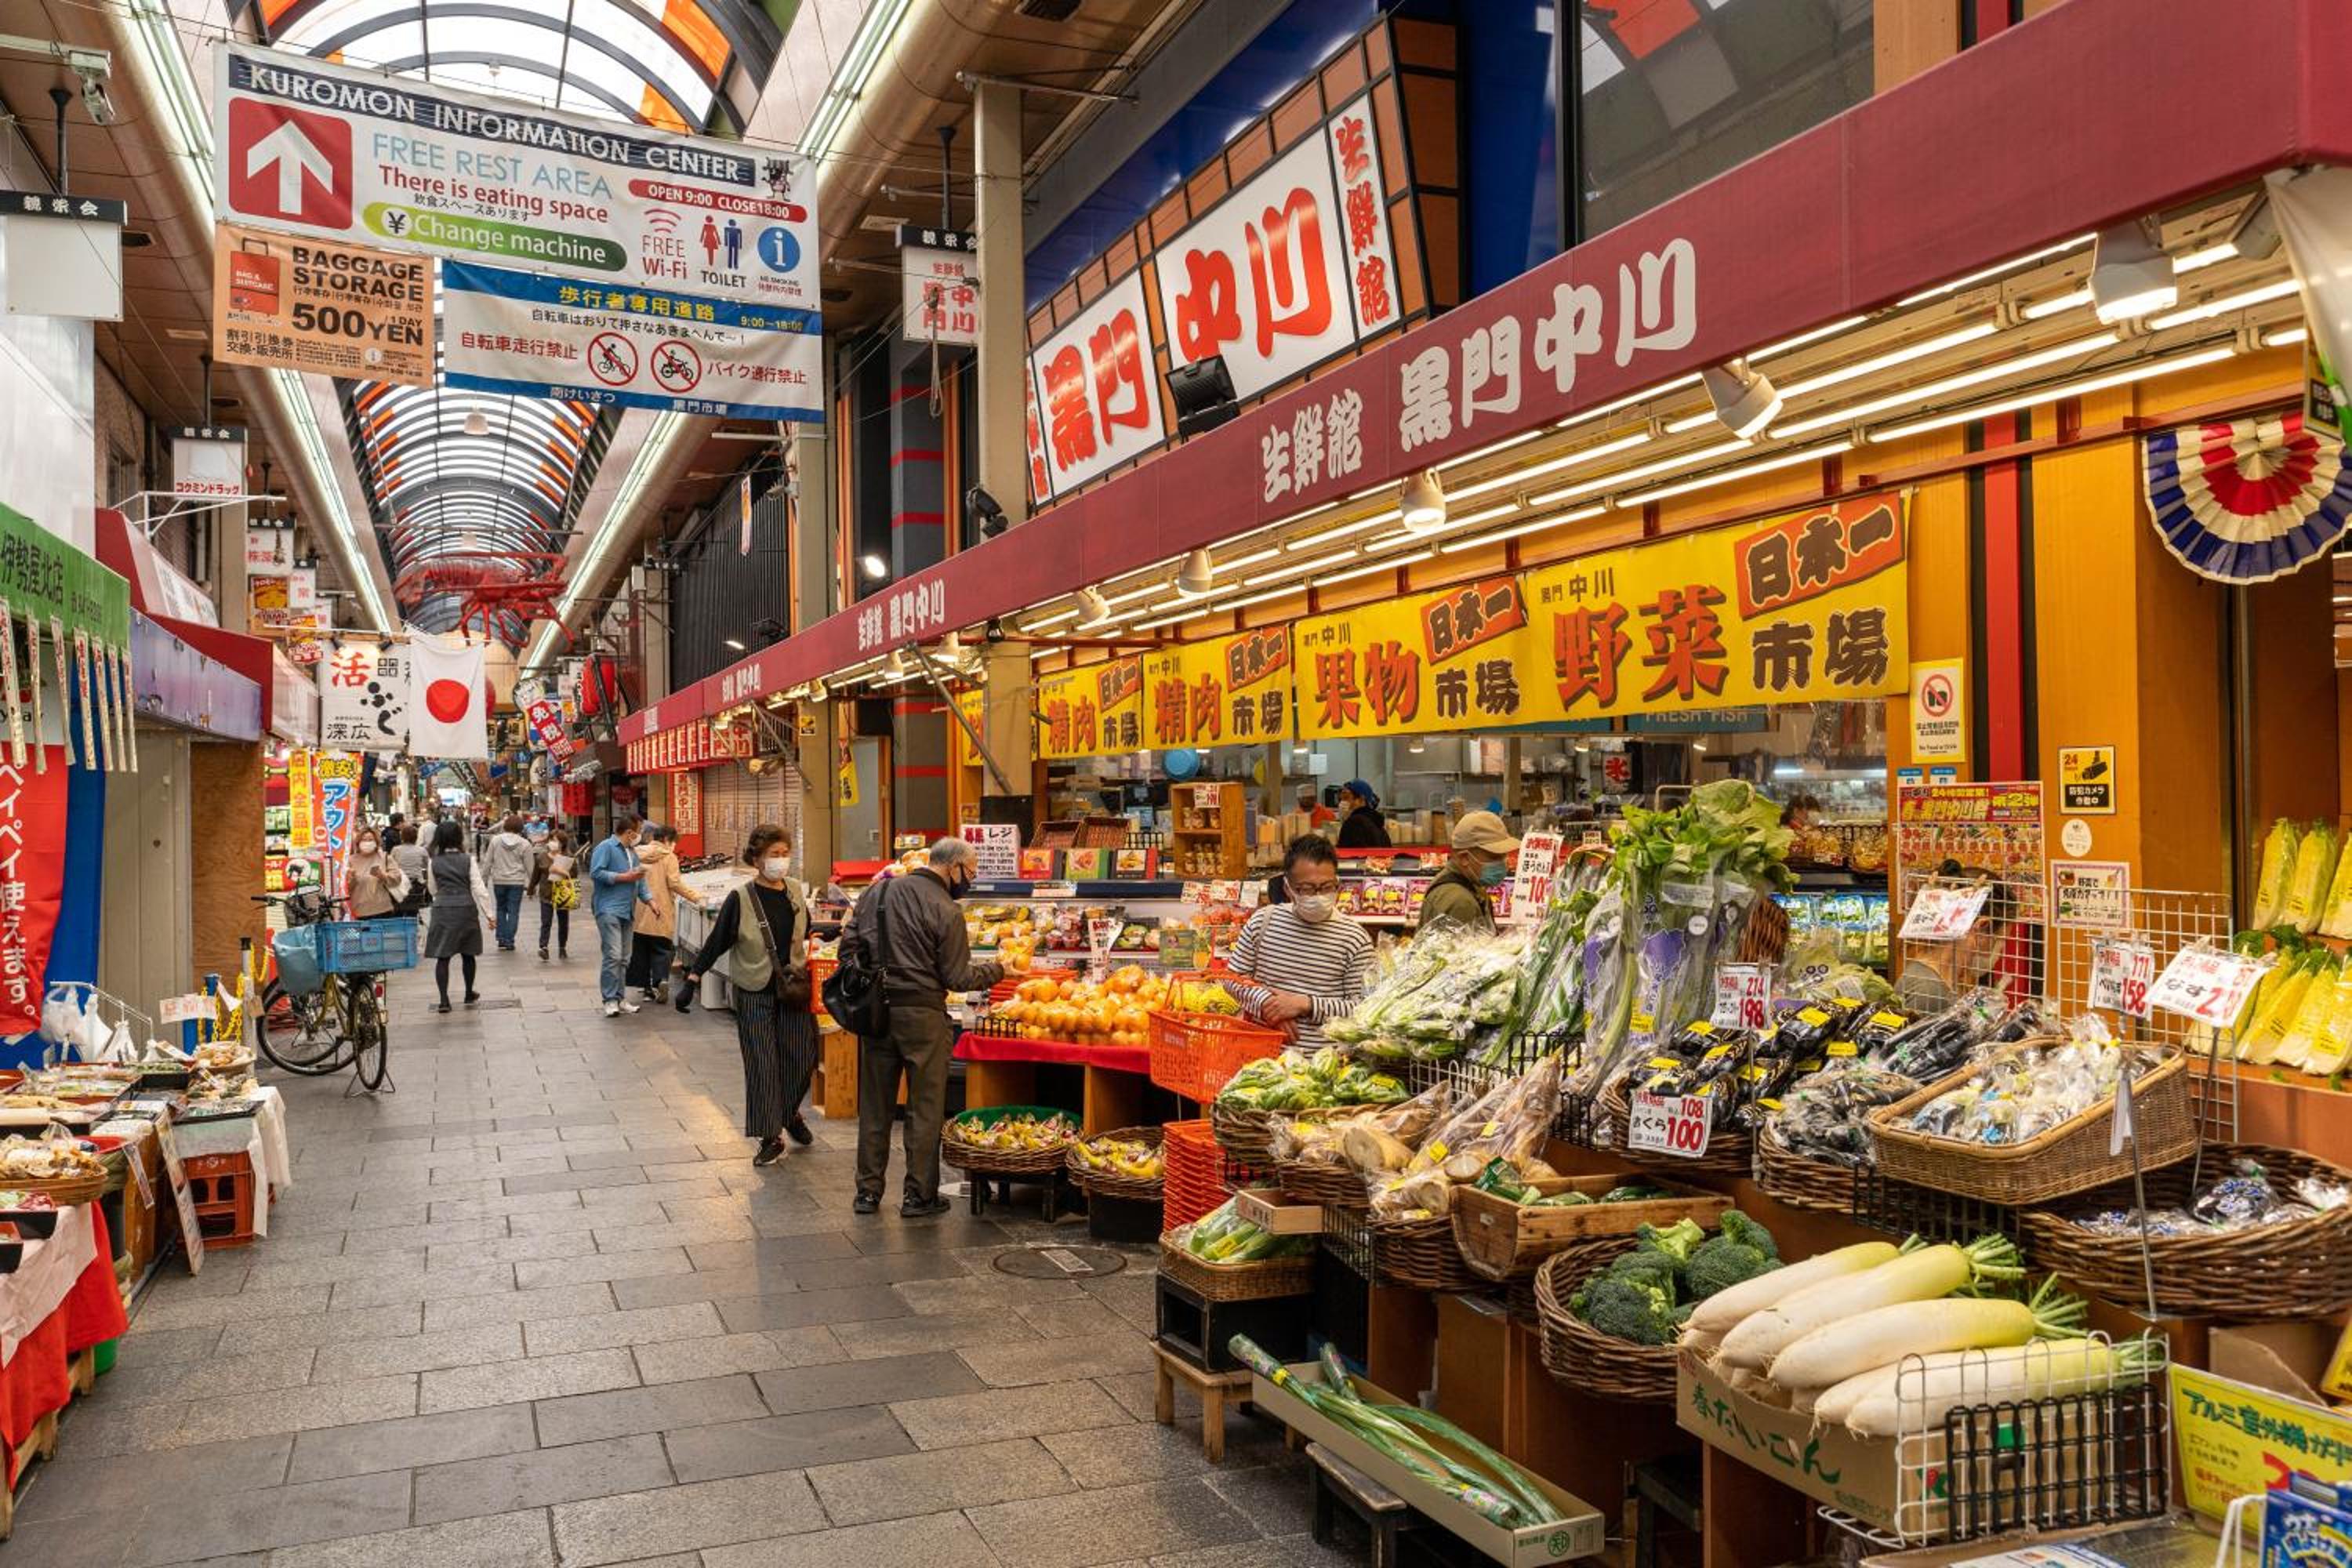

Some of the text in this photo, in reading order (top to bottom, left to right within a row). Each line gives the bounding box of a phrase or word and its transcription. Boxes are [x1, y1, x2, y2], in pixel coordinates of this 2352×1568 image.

[250, 64, 739, 182] KUROMON INFORMATION CENTER
[372, 132, 613, 200] FREE REST AREA
[379, 164, 609, 223] There is eating space
[413, 193, 531, 222] 飲食スペースあります
[648, 184, 683, 202] OPEN
[686, 191, 713, 207] 9:00
[415, 214, 504, 251] Change
[510, 233, 607, 263] machine
[642, 234, 686, 259] FREE
[292, 245, 424, 282] BAGGAGE
[643, 257, 688, 281] Wi-Fi
[700, 270, 746, 289] TOILET
[292, 266, 424, 303] STORAGE
[559, 285, 716, 321] 歩行者専用道路
[399, 316, 423, 328] DAY
[1043, 187, 1333, 472] 黒門 中川
[461, 331, 579, 361] 自転車走行禁止
[707, 360, 808, 385] バイク通行禁止
[1261, 237, 1697, 503] 生鮮館 黒門中川
[673, 398, 728, 415] 黒門市場
[176, 481, 240, 495] コクミンドラッグ
[1747, 505, 1896, 605] 日本一
[1428, 584, 1513, 657] 日本一
[1228, 630, 1287, 684] 日本一
[1553, 584, 1730, 712] 野菜
[1752, 608, 1889, 691] 市場
[330, 652, 371, 688] 活
[1315, 640, 1421, 729] 果物
[1436, 659, 1521, 719] 市場
[532, 705, 562, 741] 免税
[1047, 694, 1098, 753] 精肉
[1154, 673, 1223, 745] 精肉
[1232, 690, 1284, 737] 市場
[1103, 710, 1139, 750] 市場
[2063, 753, 2078, 766] 24
[2068, 786, 2105, 796] 防犯カメラ
[989, 827, 1012, 839] レジ
[2122, 978, 2147, 1014] 158
[2165, 978, 2208, 998] なす
[1738, 997, 1765, 1029] 198
[1681, 1098, 1704, 1119] 108
[1667, 1116, 1704, 1152] 100
